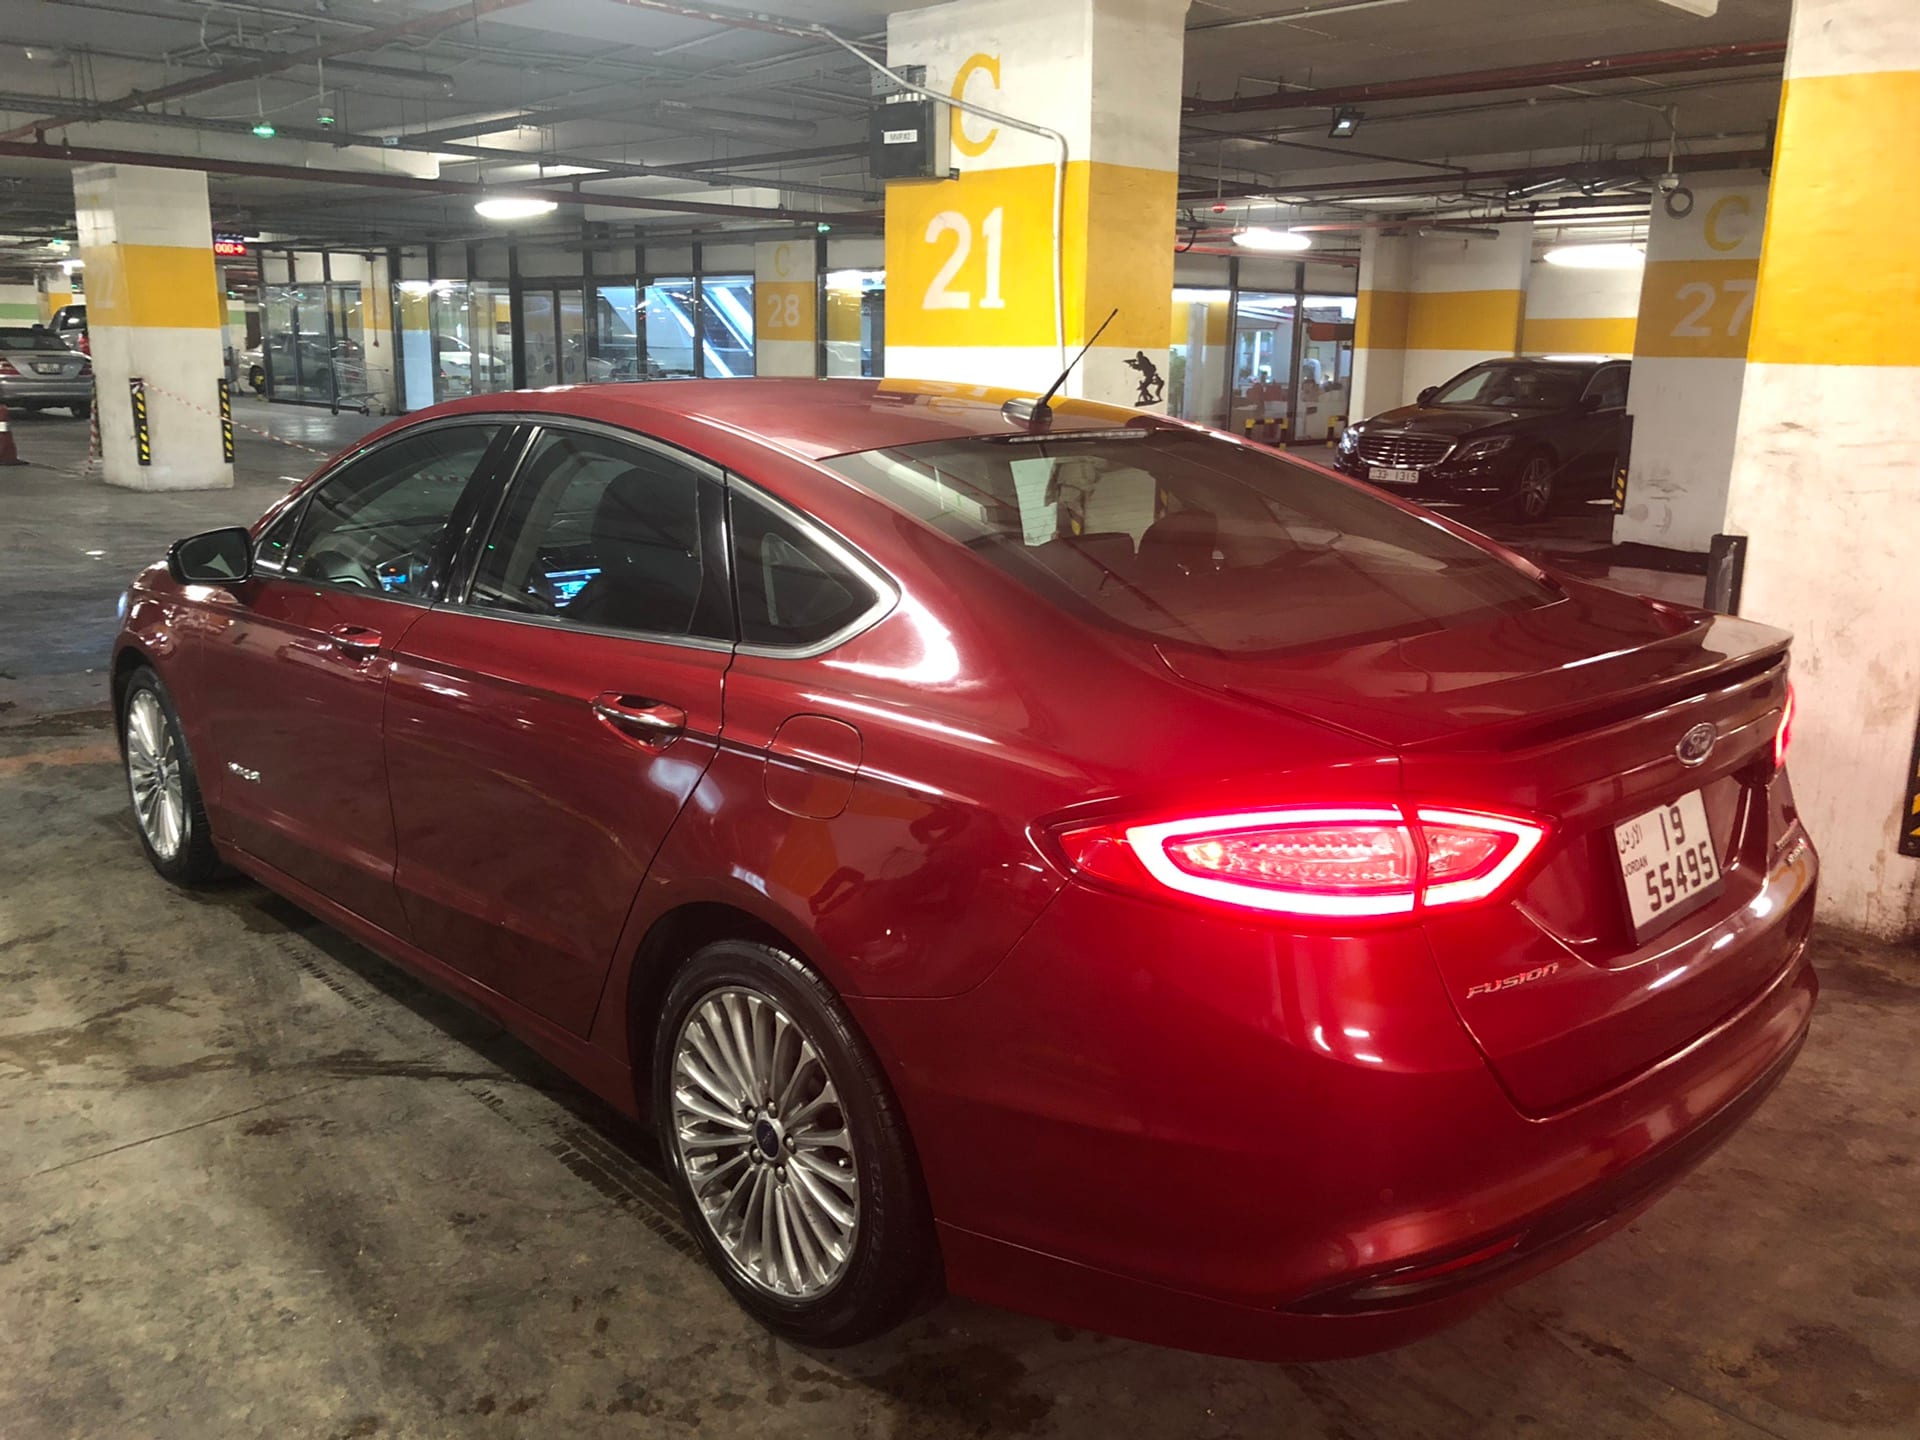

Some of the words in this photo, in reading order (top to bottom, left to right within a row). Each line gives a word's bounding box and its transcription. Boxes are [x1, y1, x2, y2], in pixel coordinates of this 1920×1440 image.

[951, 53, 1001, 158] C
[1703, 194, 1751, 252] C
[775, 244, 792, 278] C
[922, 207, 1005, 310] 21
[767, 294, 800, 328] 28
[1670, 279, 1757, 337] 27
[1659, 806, 1686, 852] 19
[1625, 855, 1649, 877] JORDAN
[1645, 841, 1714, 912] 55495
[1466, 962, 1559, 999] FUSION
